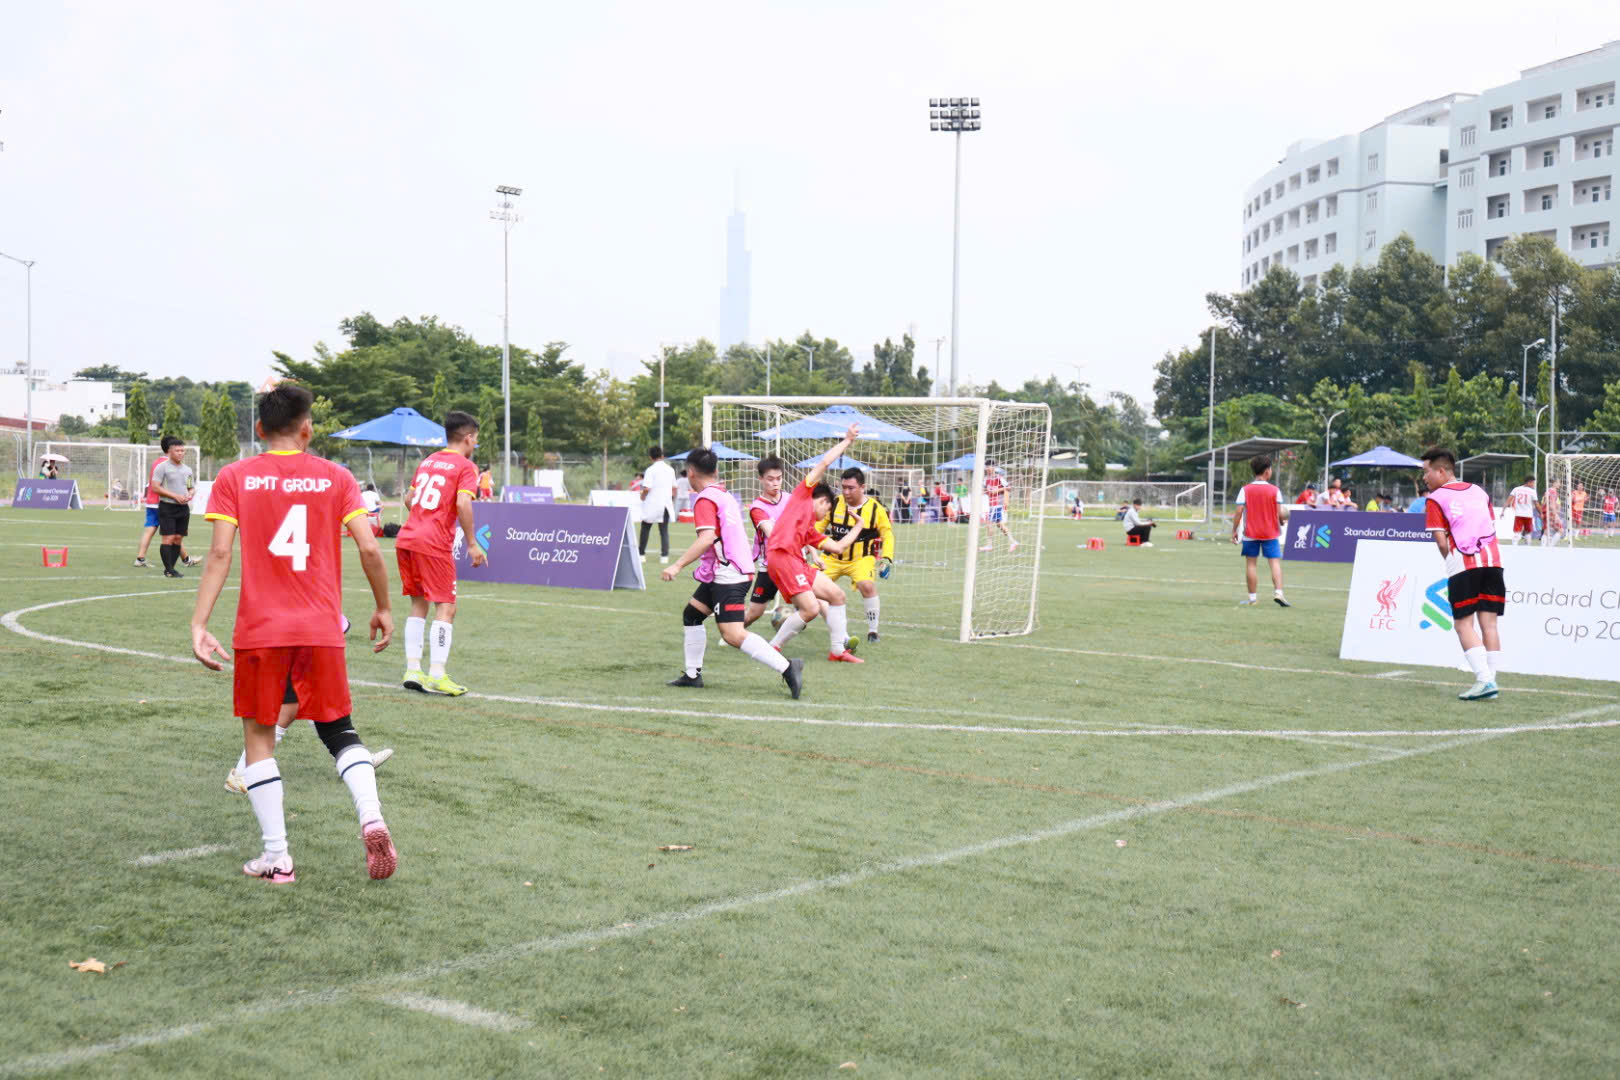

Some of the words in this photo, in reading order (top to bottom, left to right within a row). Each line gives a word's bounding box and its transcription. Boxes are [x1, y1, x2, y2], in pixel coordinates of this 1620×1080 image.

[244, 476, 279, 491] BMT
[282, 477, 332, 493] GROUP
[411, 473, 446, 510] 36
[1517, 493, 1529, 505] 21
[267, 504, 311, 571] 4
[506, 527, 555, 543] Standard
[556, 529, 611, 546] Chartered
[1344, 526, 1385, 537] Standard
[1294, 540, 1307, 549] LFC
[528, 547, 550, 564] Cup
[551, 549, 579, 563] 2025
[1600, 589, 1620, 609] C
[1369, 616, 1396, 631] LFC
[1544, 616, 1589, 643] Cup
